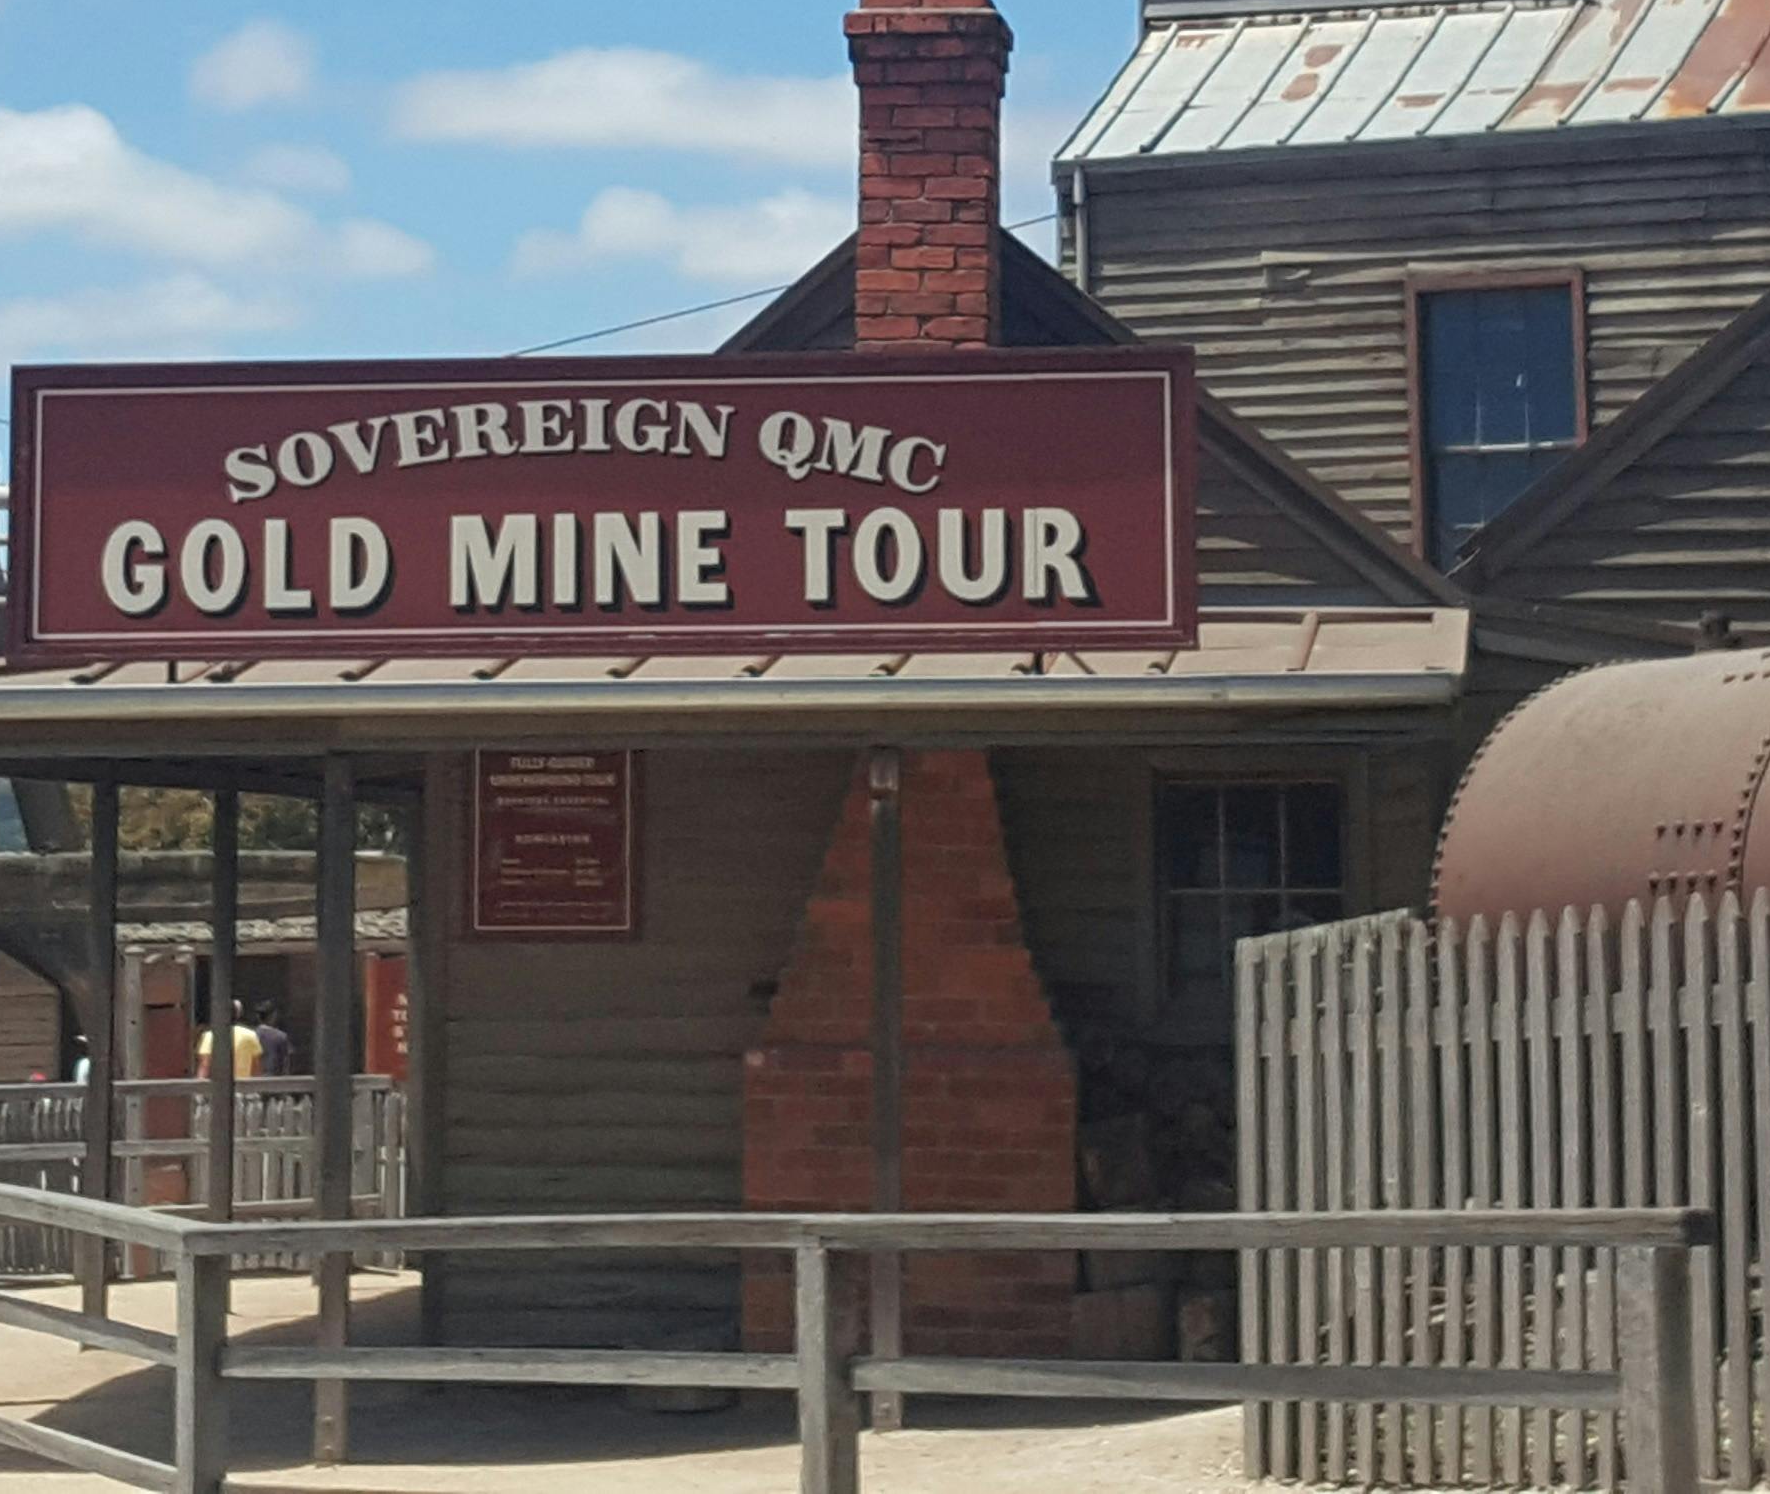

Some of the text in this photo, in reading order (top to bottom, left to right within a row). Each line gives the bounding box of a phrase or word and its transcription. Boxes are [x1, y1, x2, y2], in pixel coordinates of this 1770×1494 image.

[224, 398, 947, 504] SOVEREIGN QMC
[100, 506, 1091, 616] GOLD MINE TOUR
